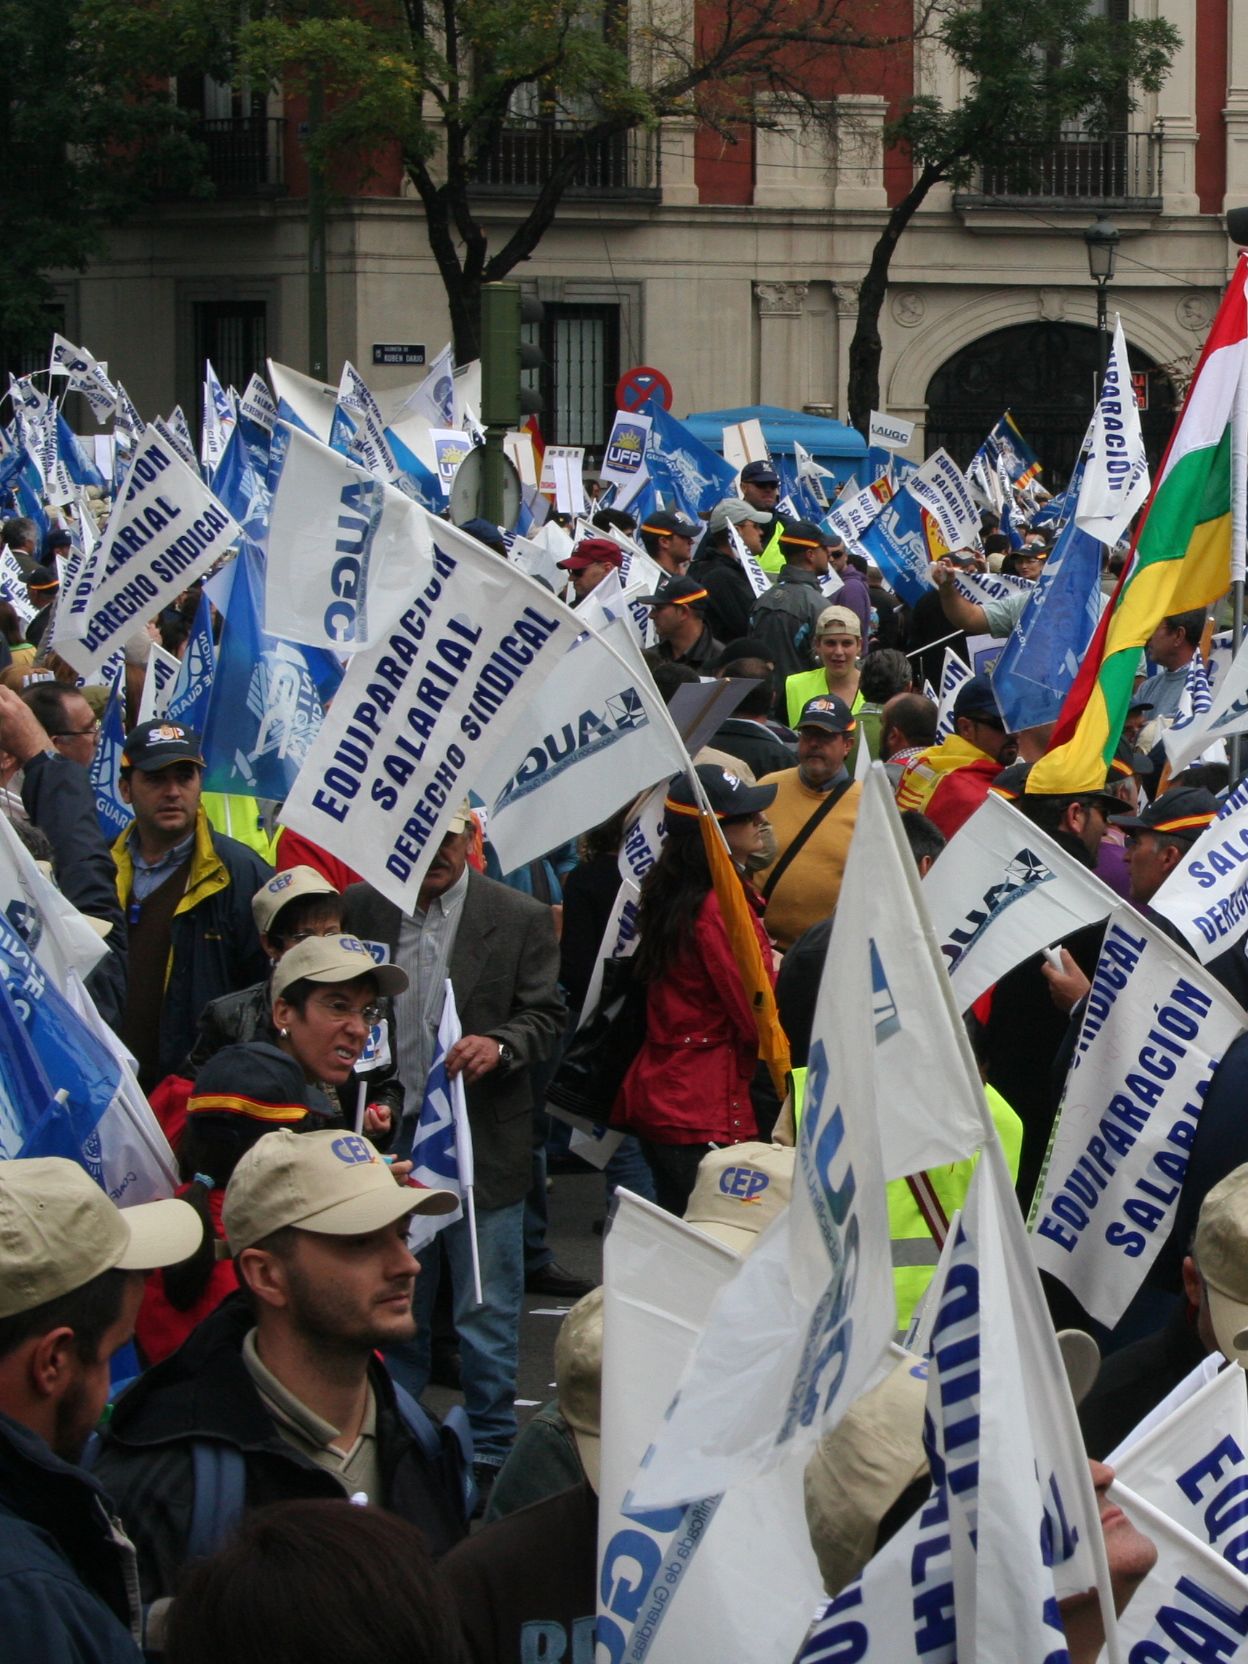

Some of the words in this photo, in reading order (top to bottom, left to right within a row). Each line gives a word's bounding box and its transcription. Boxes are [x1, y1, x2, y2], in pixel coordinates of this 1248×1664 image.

[609, 446, 642, 466] UFP
[875, 426, 909, 443] AUGC
[931, 474, 967, 525] SALARIAL
[937, 504, 962, 545] SINDICAL
[79, 573, 159, 653] DERECHO
[150, 503, 230, 584] SINDICAL
[100, 495, 183, 590] LARIAL
[371, 617, 483, 812] SALARIAL
[386, 742, 466, 885] DERECHO
[460, 606, 560, 741] SINDICAL
[268, 874, 292, 894] CEP
[1038, 978, 1214, 1254] EQUIPARACIÓN
[719, 1167, 770, 1197] CEP
[1105, 1058, 1220, 1258] SALARI
